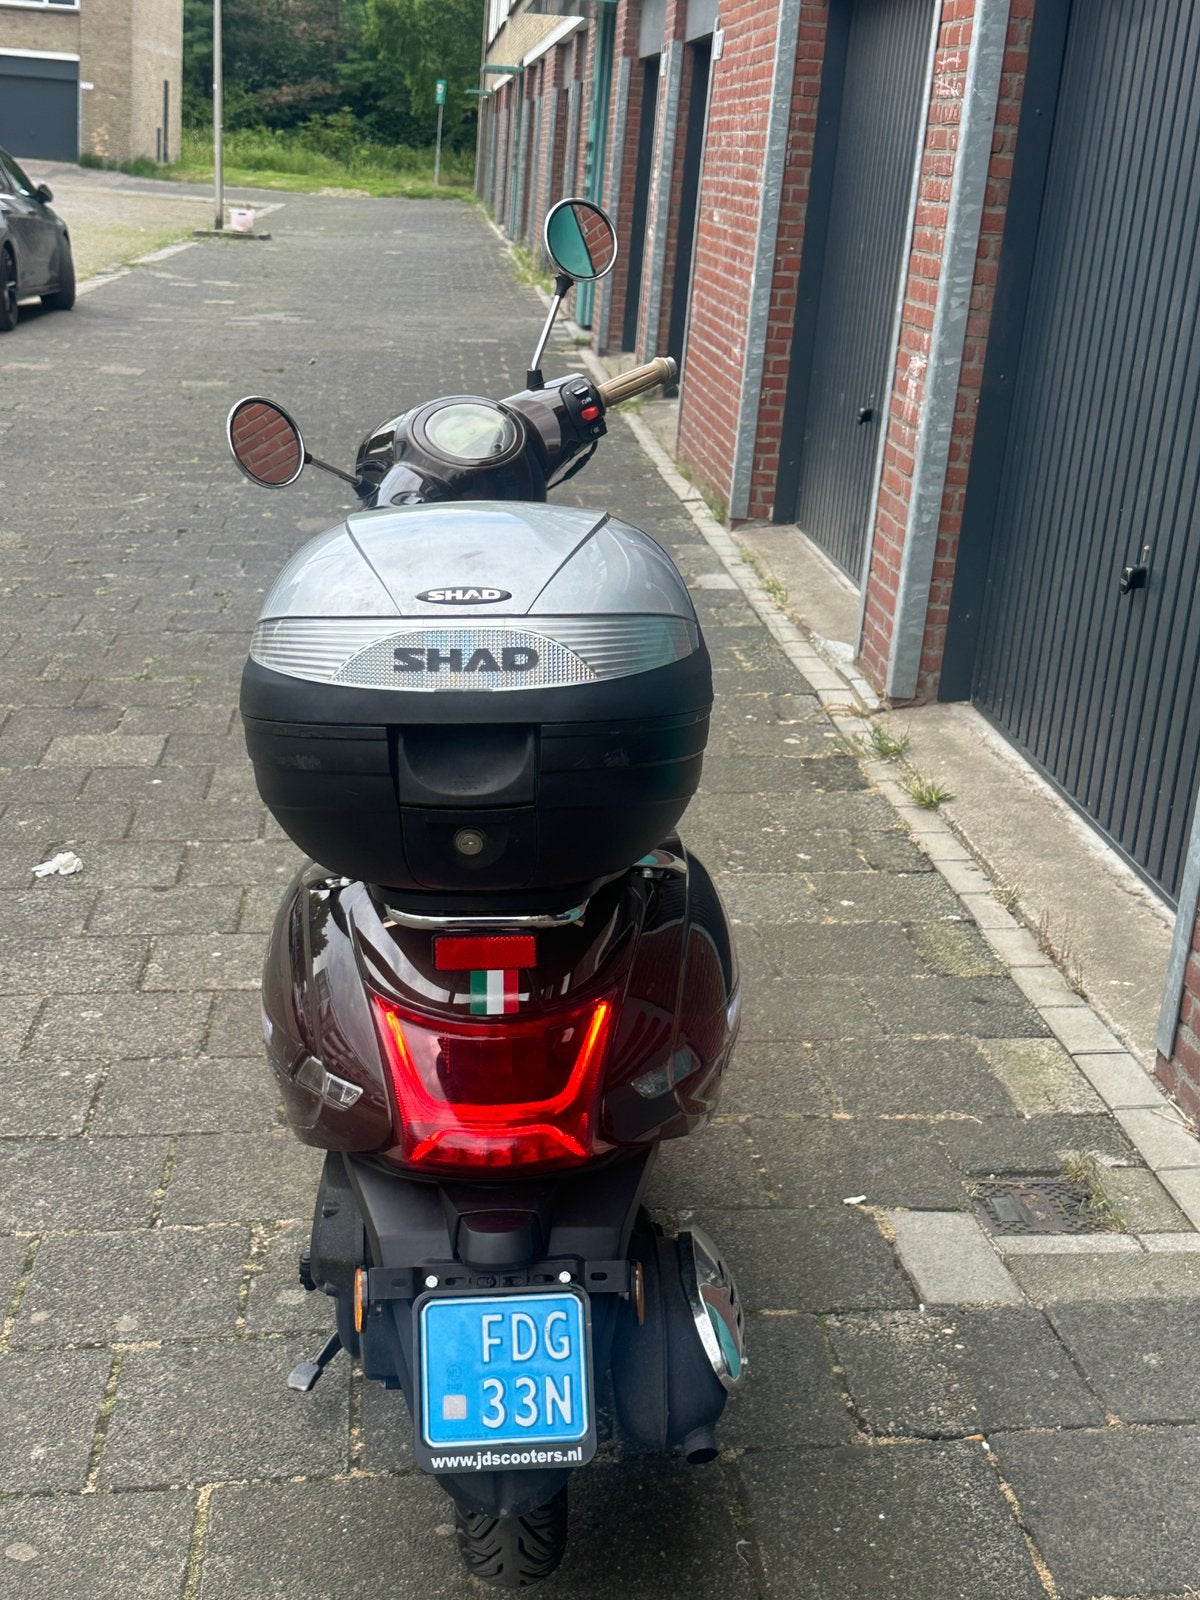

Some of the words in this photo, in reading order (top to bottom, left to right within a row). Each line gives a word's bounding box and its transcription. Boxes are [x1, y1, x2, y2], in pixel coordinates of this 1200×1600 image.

[427, 589, 501, 601] SHAD
[393, 647, 539, 672] SHAD
[481, 1310, 572, 1363] FDG
[481, 1374, 573, 1429] 33N
[431, 1446, 583, 1470] www.jdscooters.nl
